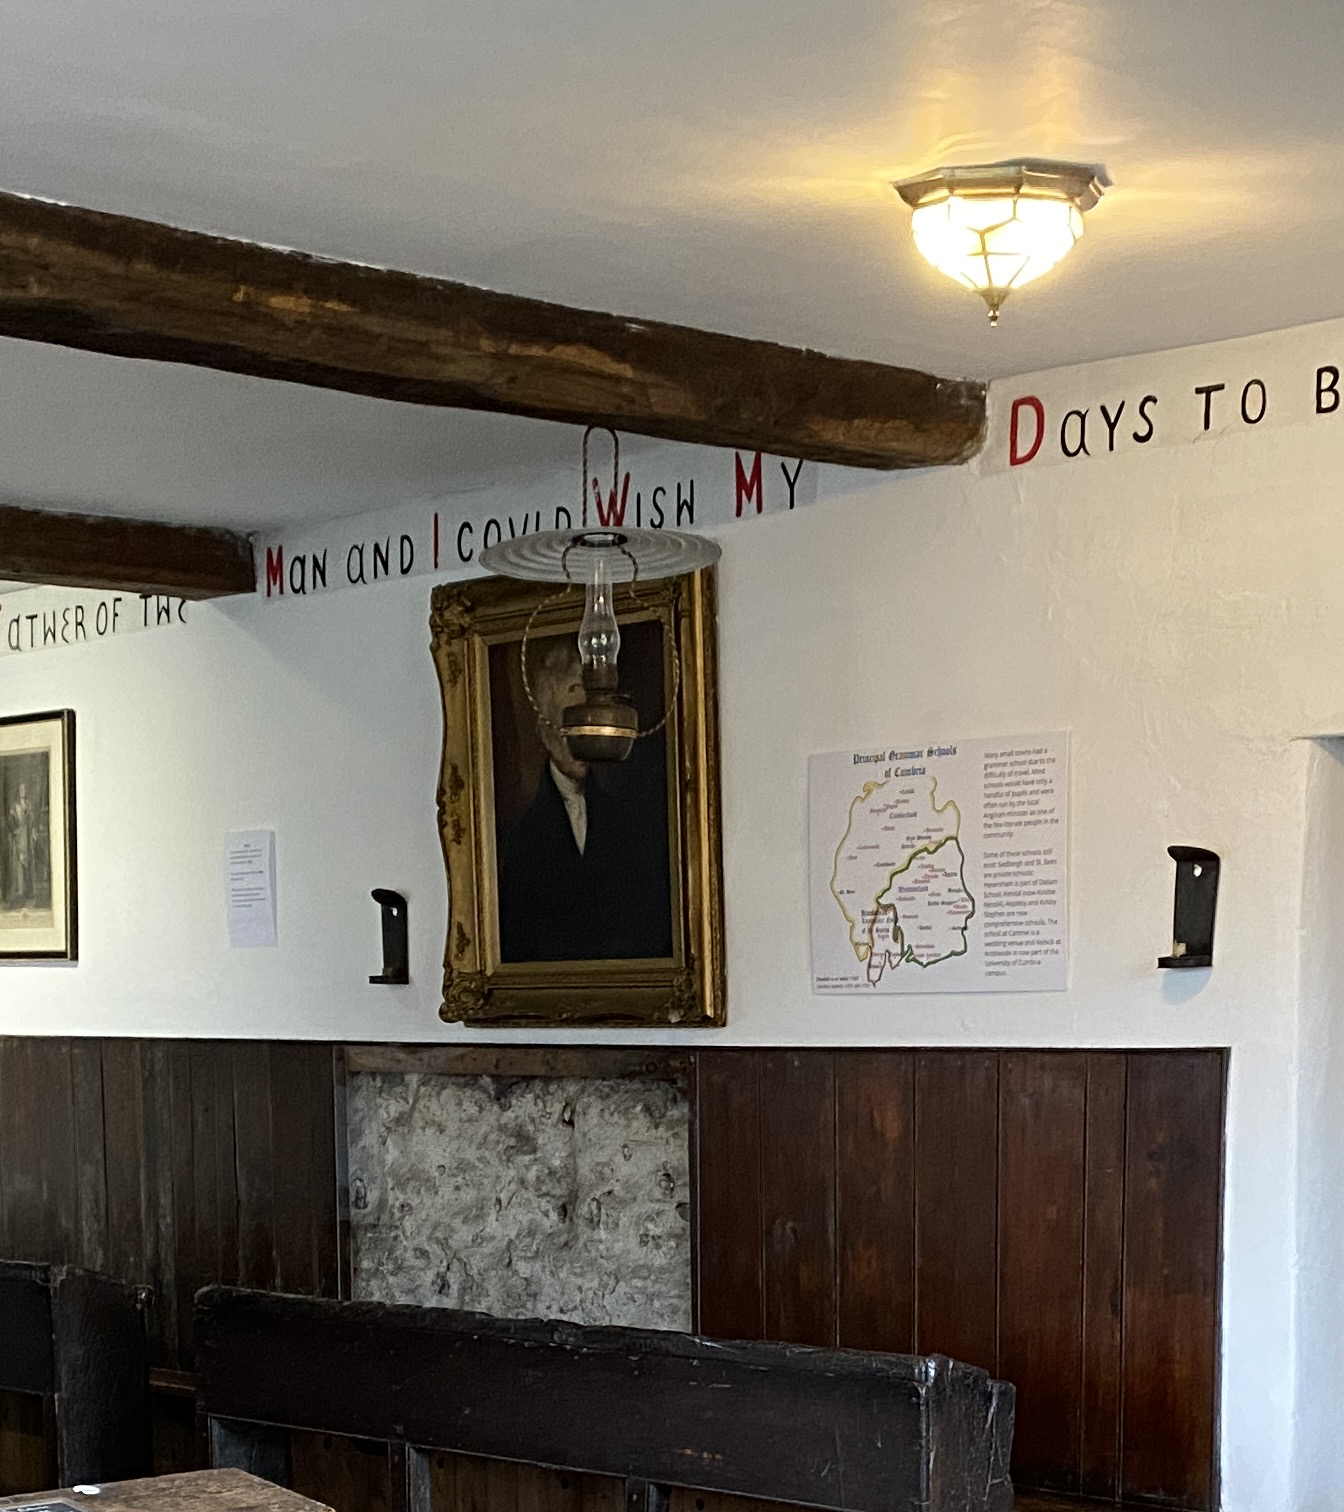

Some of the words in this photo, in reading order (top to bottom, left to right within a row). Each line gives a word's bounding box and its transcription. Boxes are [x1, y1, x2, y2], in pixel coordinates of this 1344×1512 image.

[1194, 378, 1268, 431] TO
[432, 512, 440, 570] I
[734, 450, 804, 519] MY
[96, 596, 124, 638] OF
